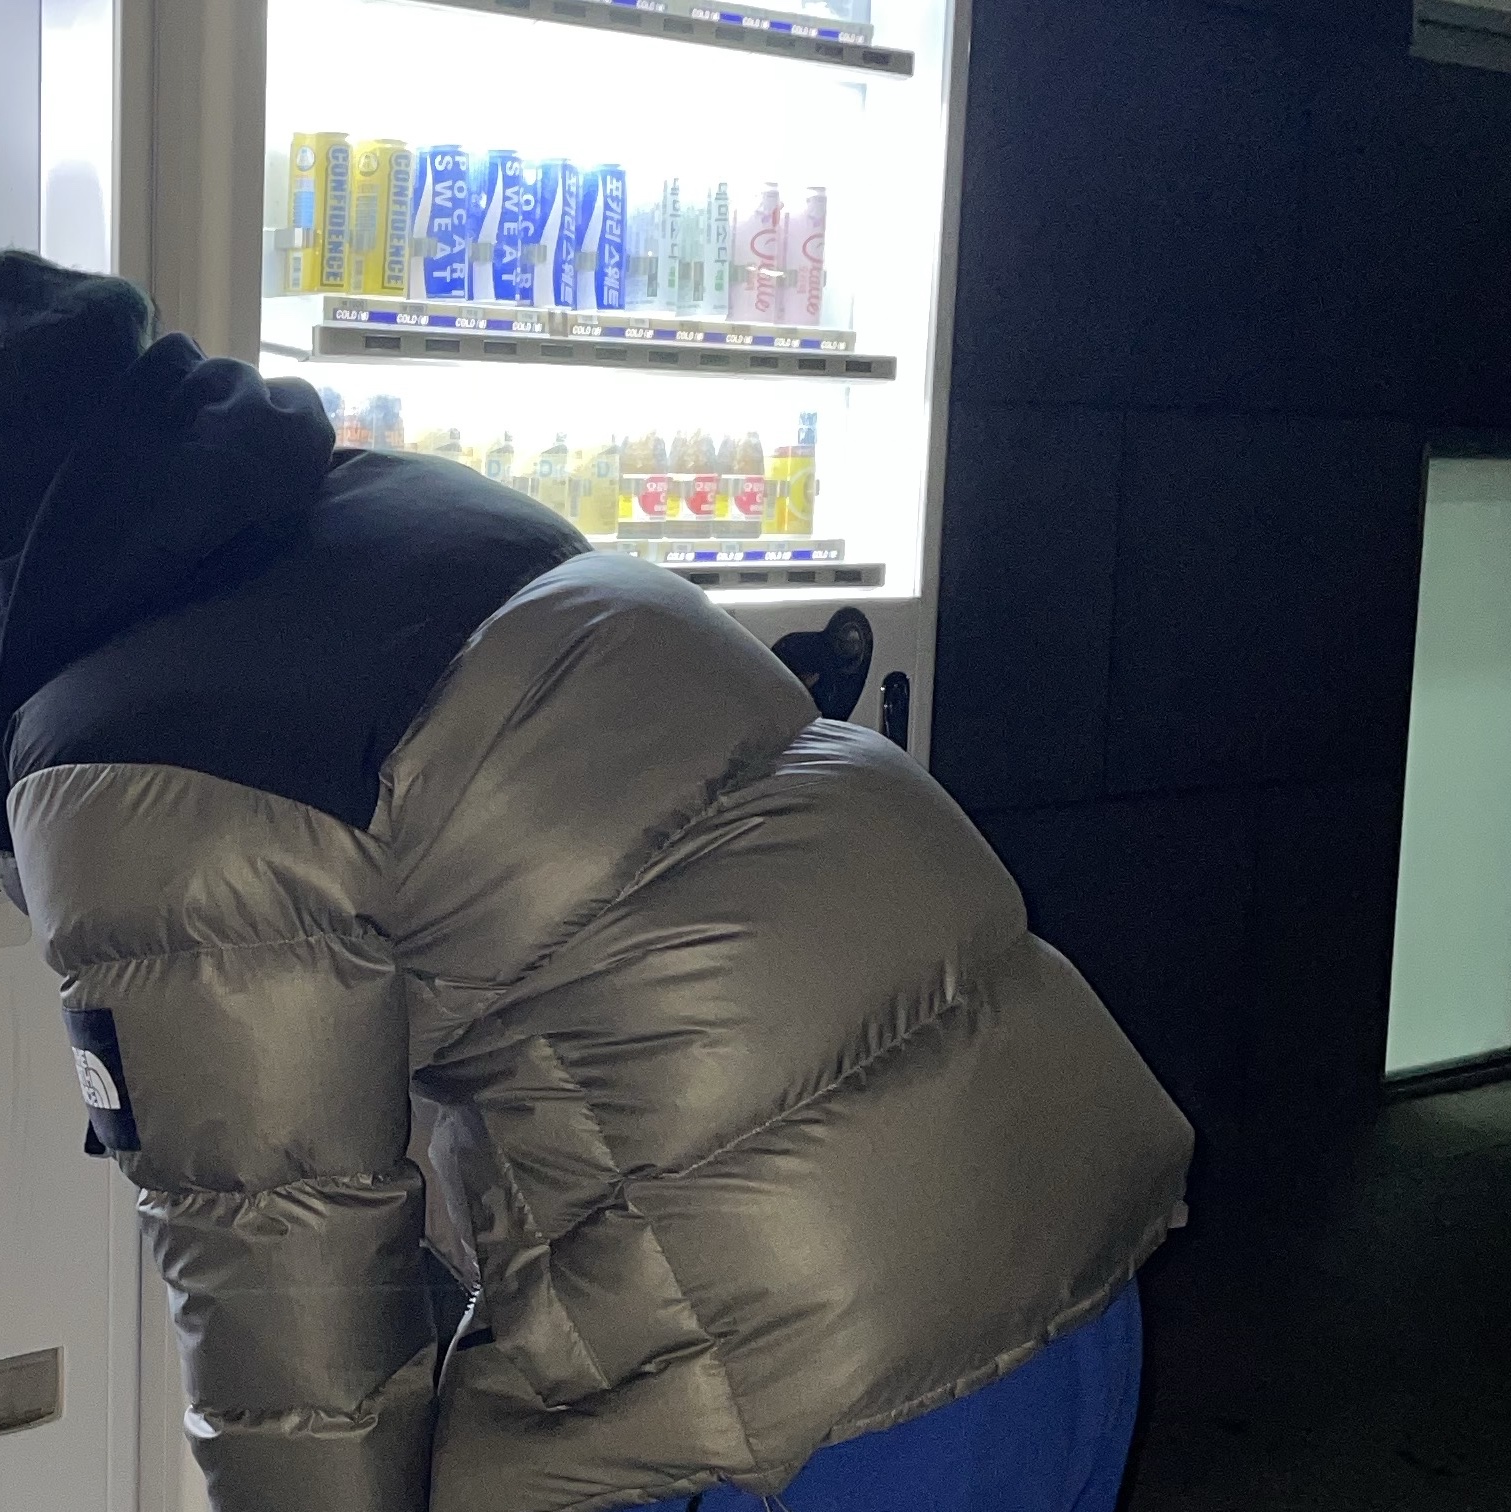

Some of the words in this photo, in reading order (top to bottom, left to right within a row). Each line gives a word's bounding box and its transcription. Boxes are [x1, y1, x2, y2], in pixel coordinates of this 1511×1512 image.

[326, 145, 349, 283] CONFIDENCE
[388, 153, 411, 285] CONFIDENCE
[432, 154, 453, 283] SWEAT
[451, 155, 467, 296] POCARI
[501, 160, 519, 287] SWEAT
